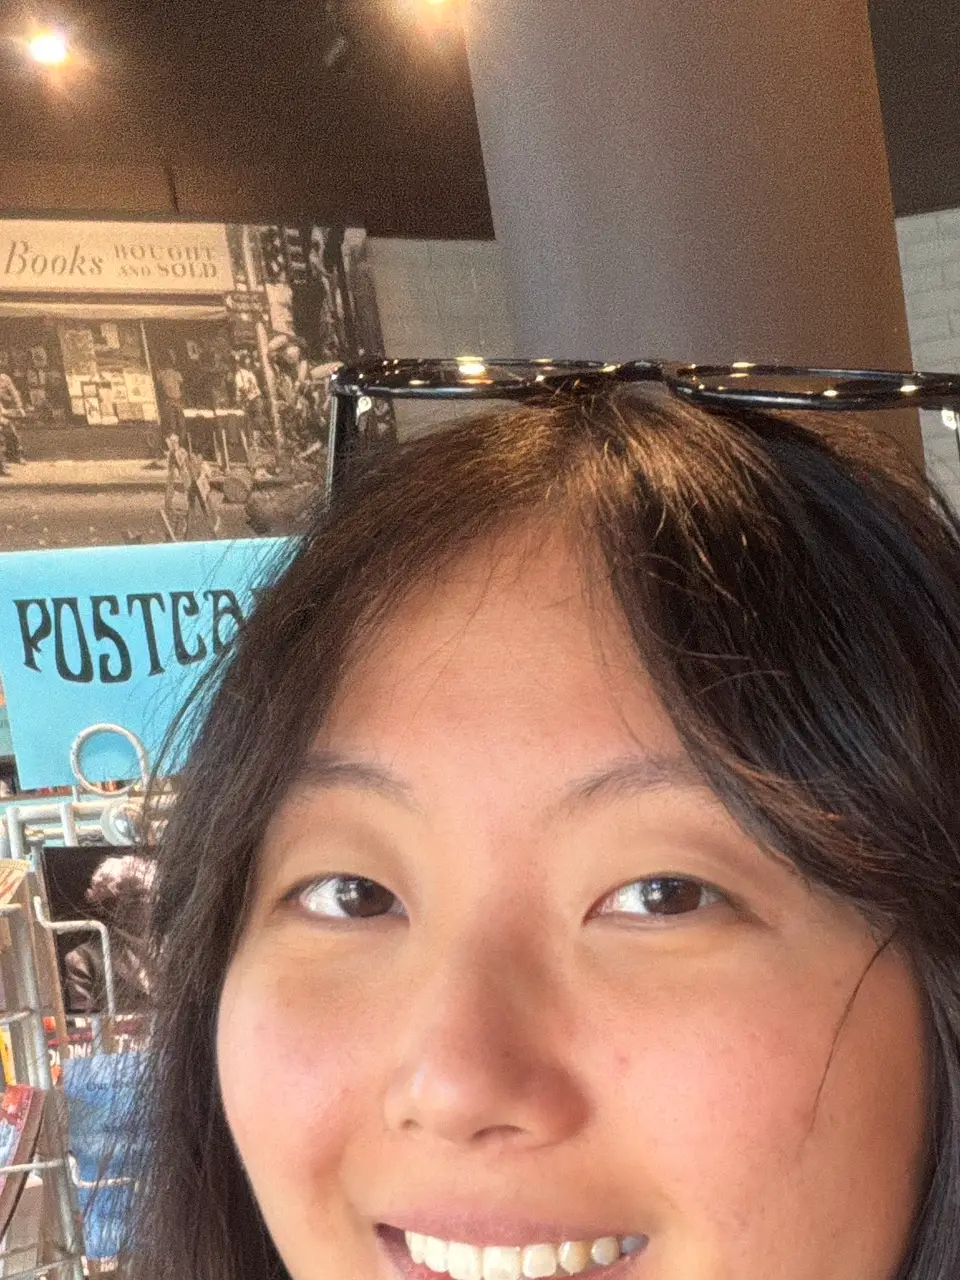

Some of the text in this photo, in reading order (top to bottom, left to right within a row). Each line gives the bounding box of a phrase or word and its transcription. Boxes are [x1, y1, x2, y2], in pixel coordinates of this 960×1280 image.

[4, 239, 103, 276] Books
[113, 243, 215, 262] BOUGHT
[156, 261, 217, 278] SOLD
